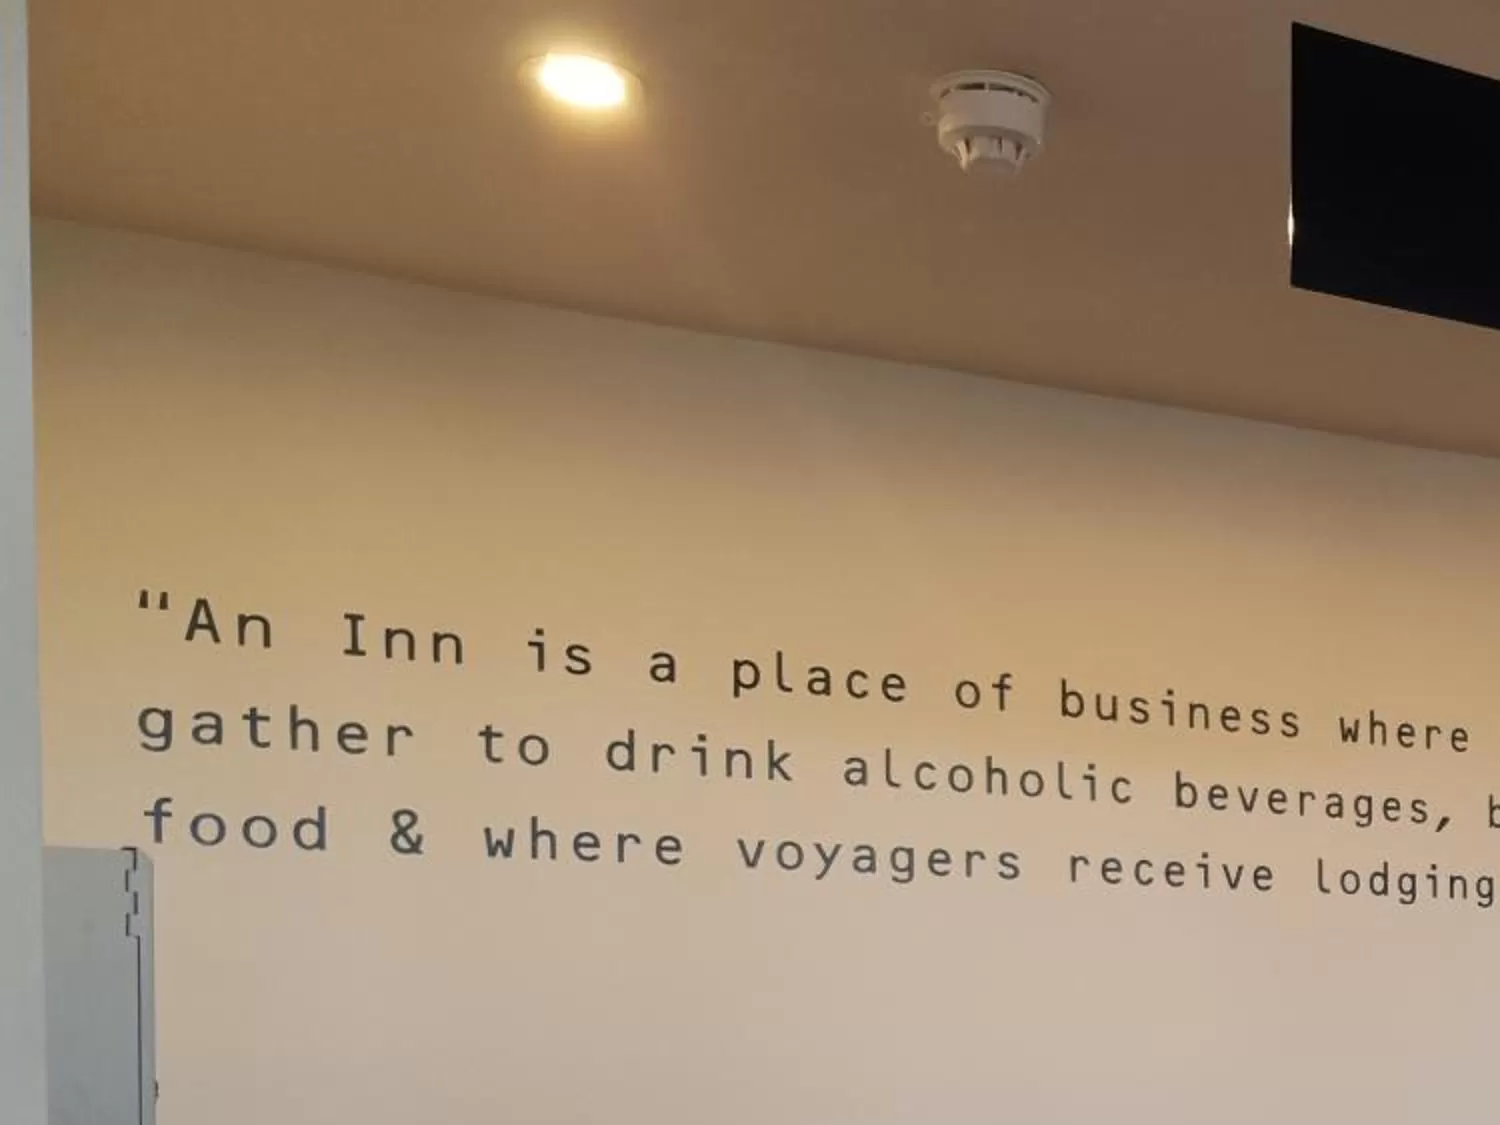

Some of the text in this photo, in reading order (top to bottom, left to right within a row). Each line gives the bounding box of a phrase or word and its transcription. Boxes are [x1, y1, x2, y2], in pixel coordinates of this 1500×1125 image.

[138, 589, 272, 649] "An
[343, 612, 463, 665] Inn
[527, 627, 592, 676] is
[649, 651, 676, 684] a
[732, 650, 906, 703] place
[954, 672, 1013, 712] of
[1060, 677, 1300, 738] business
[1338, 709, 1469, 753] where
[137, 703, 414, 757] gather
[477, 724, 549, 767] to
[605, 728, 793, 782] drink
[843, 747, 1132, 805] alcoholic
[1175, 770, 1451, 833] beverages,
[143, 796, 326, 851] food
[389, 808, 424, 855] &
[483, 815, 683, 866] where
[737, 838, 1021, 885] voyagers
[1069, 851, 1273, 892] receive
